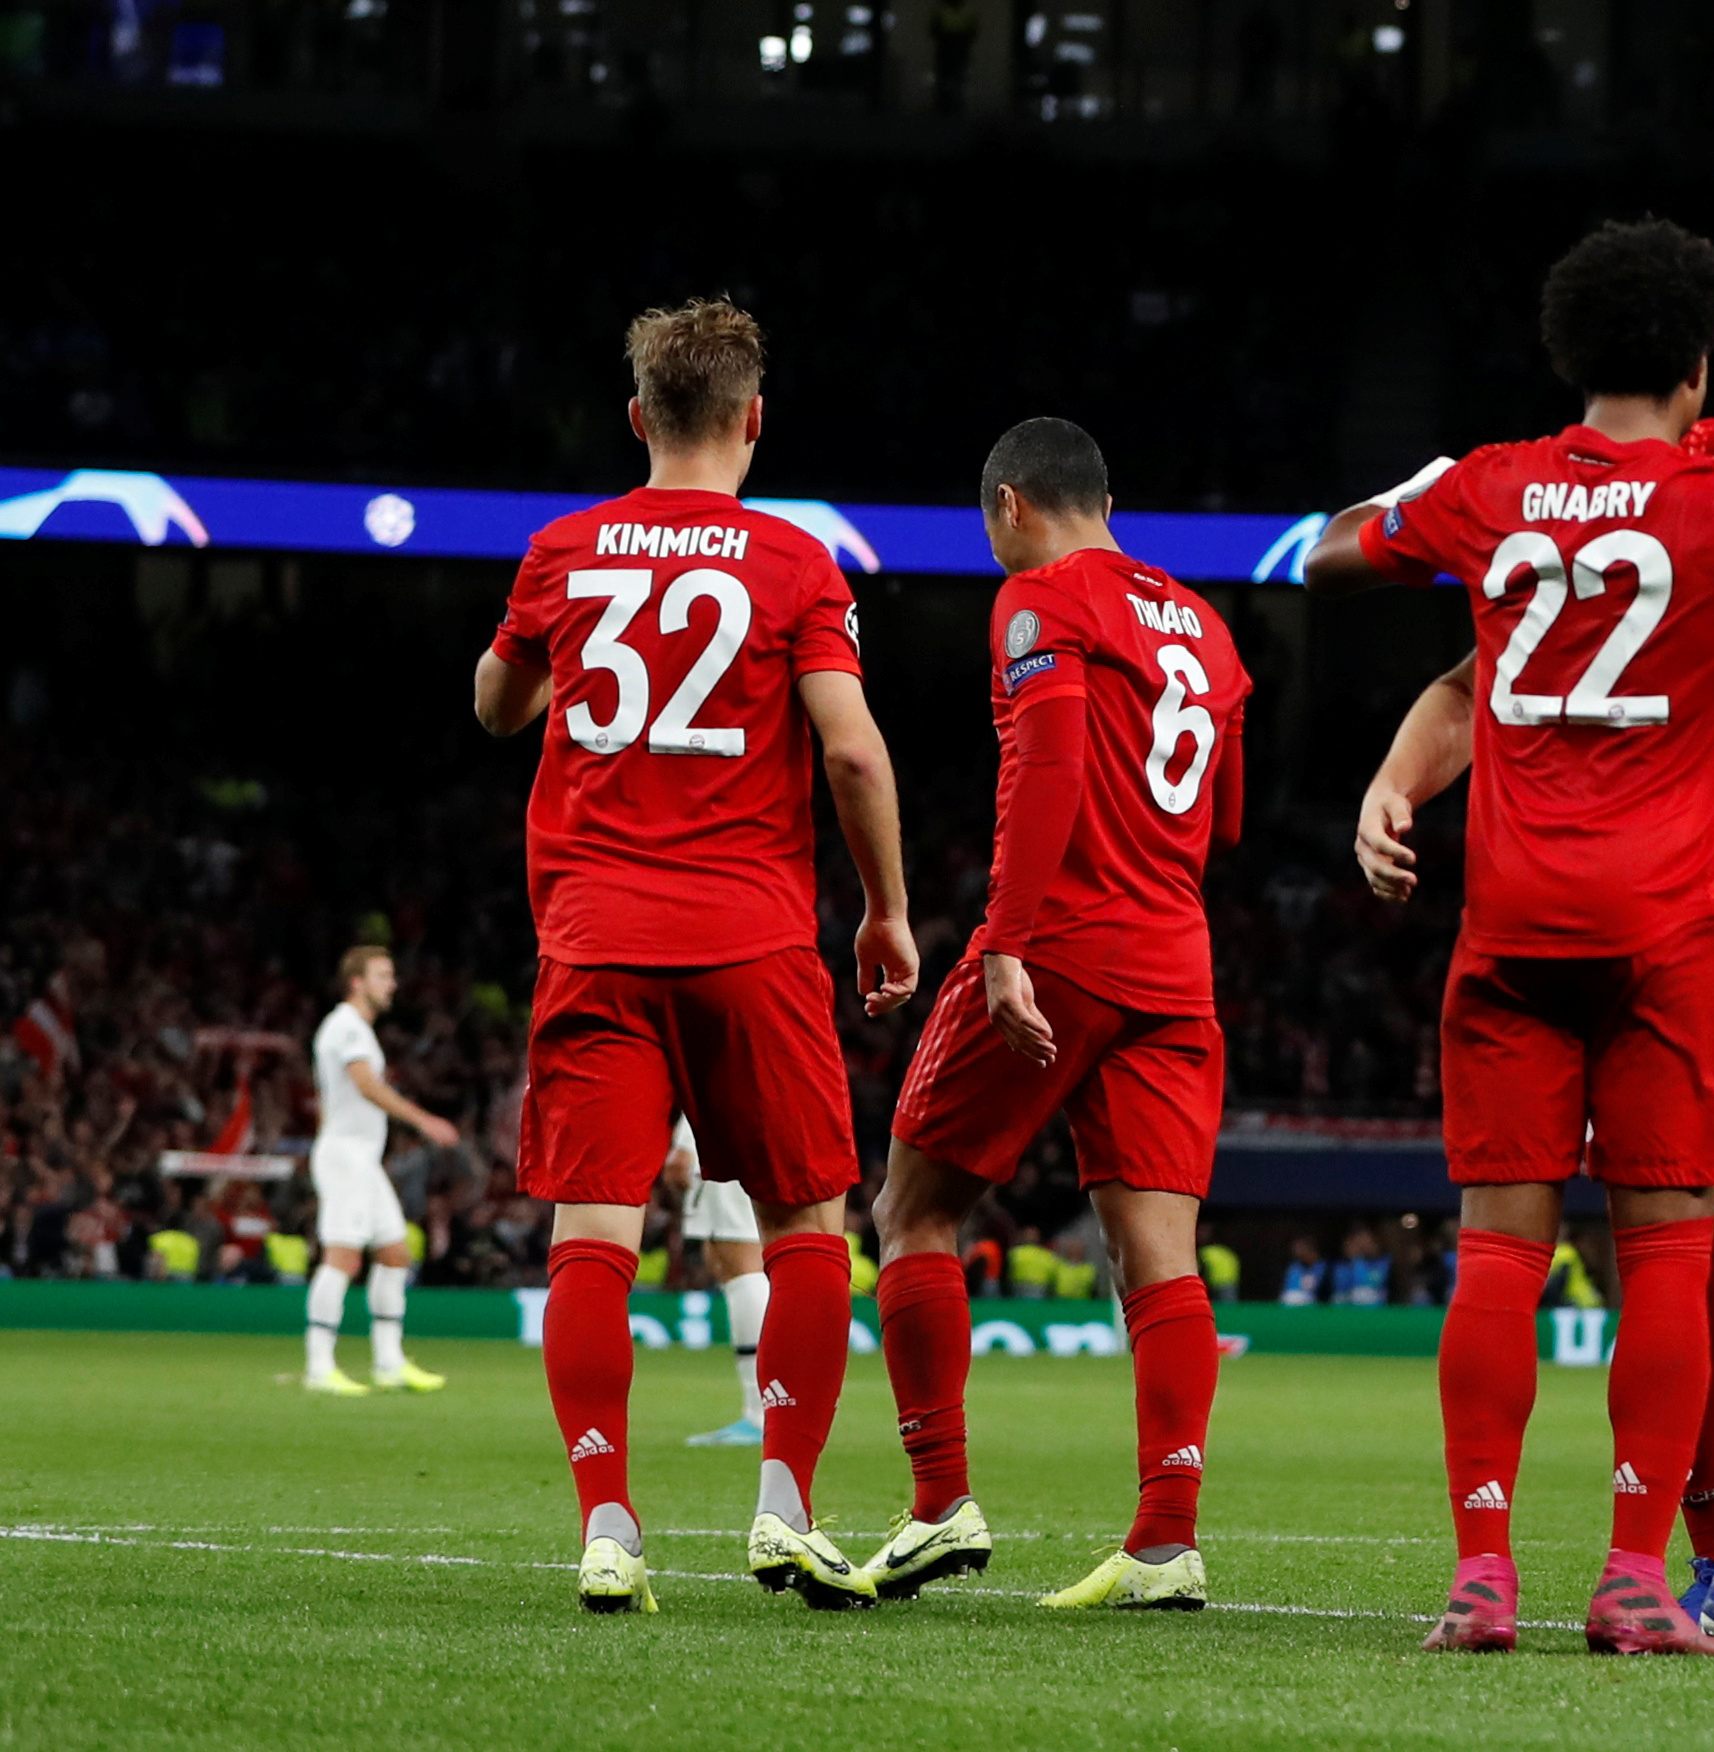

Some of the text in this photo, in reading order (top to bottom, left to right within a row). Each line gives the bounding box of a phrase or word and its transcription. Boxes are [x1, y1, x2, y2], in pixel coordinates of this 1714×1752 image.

[1522, 481, 1656, 522] GNABRY
[596, 524, 749, 560] KIMMICH
[1483, 529, 1673, 728] 22
[565, 568, 752, 756] 32
[1010, 654, 1054, 682] RESPECT
[1145, 644, 1216, 815] 6
[571, 1445, 615, 1462] adidas
[1162, 1459, 1203, 1471] adidas
[1464, 1500, 1508, 1510] adidas
